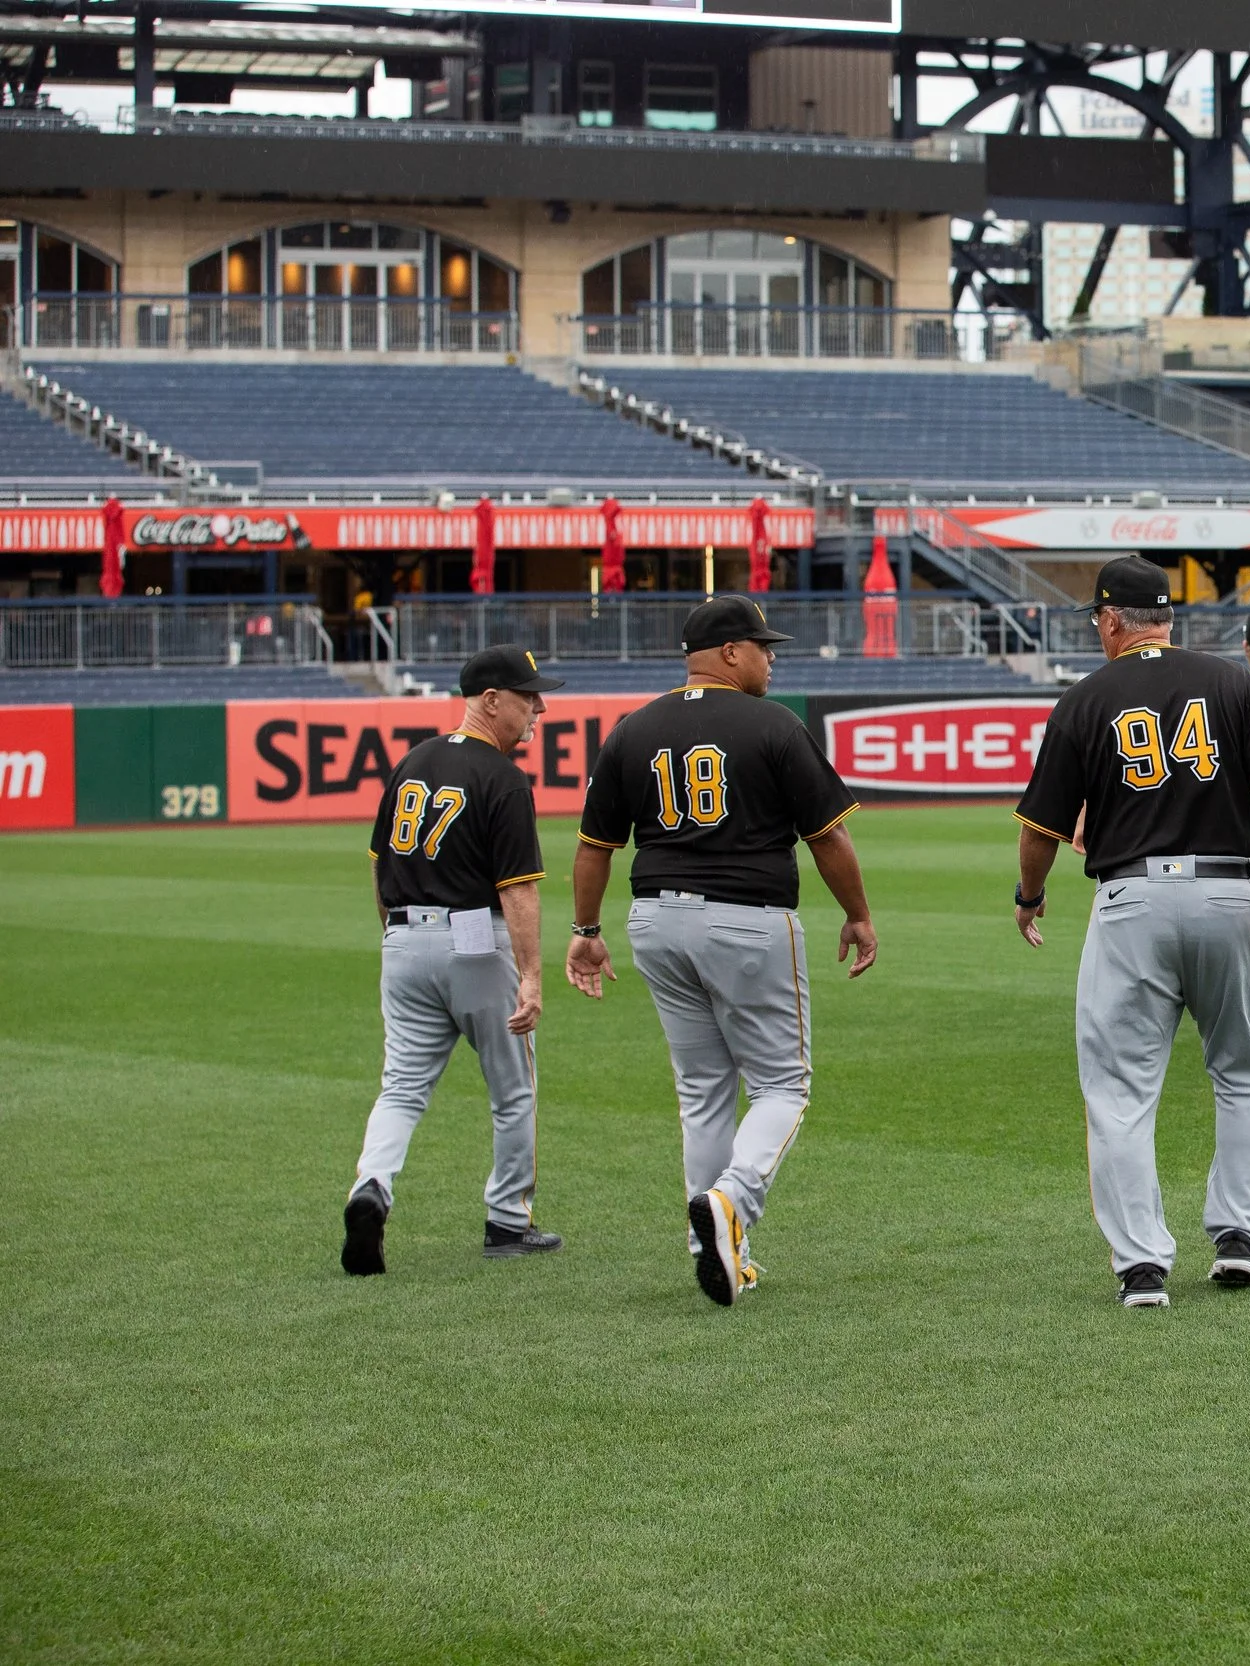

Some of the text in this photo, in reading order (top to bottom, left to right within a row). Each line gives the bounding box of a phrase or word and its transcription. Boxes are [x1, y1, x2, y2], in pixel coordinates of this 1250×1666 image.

[224, 514, 288, 545] Patio
[1111, 698, 1220, 791] 94
[162, 785, 219, 818] 379
[389, 779, 467, 860] 87
[651, 744, 729, 831] 18
